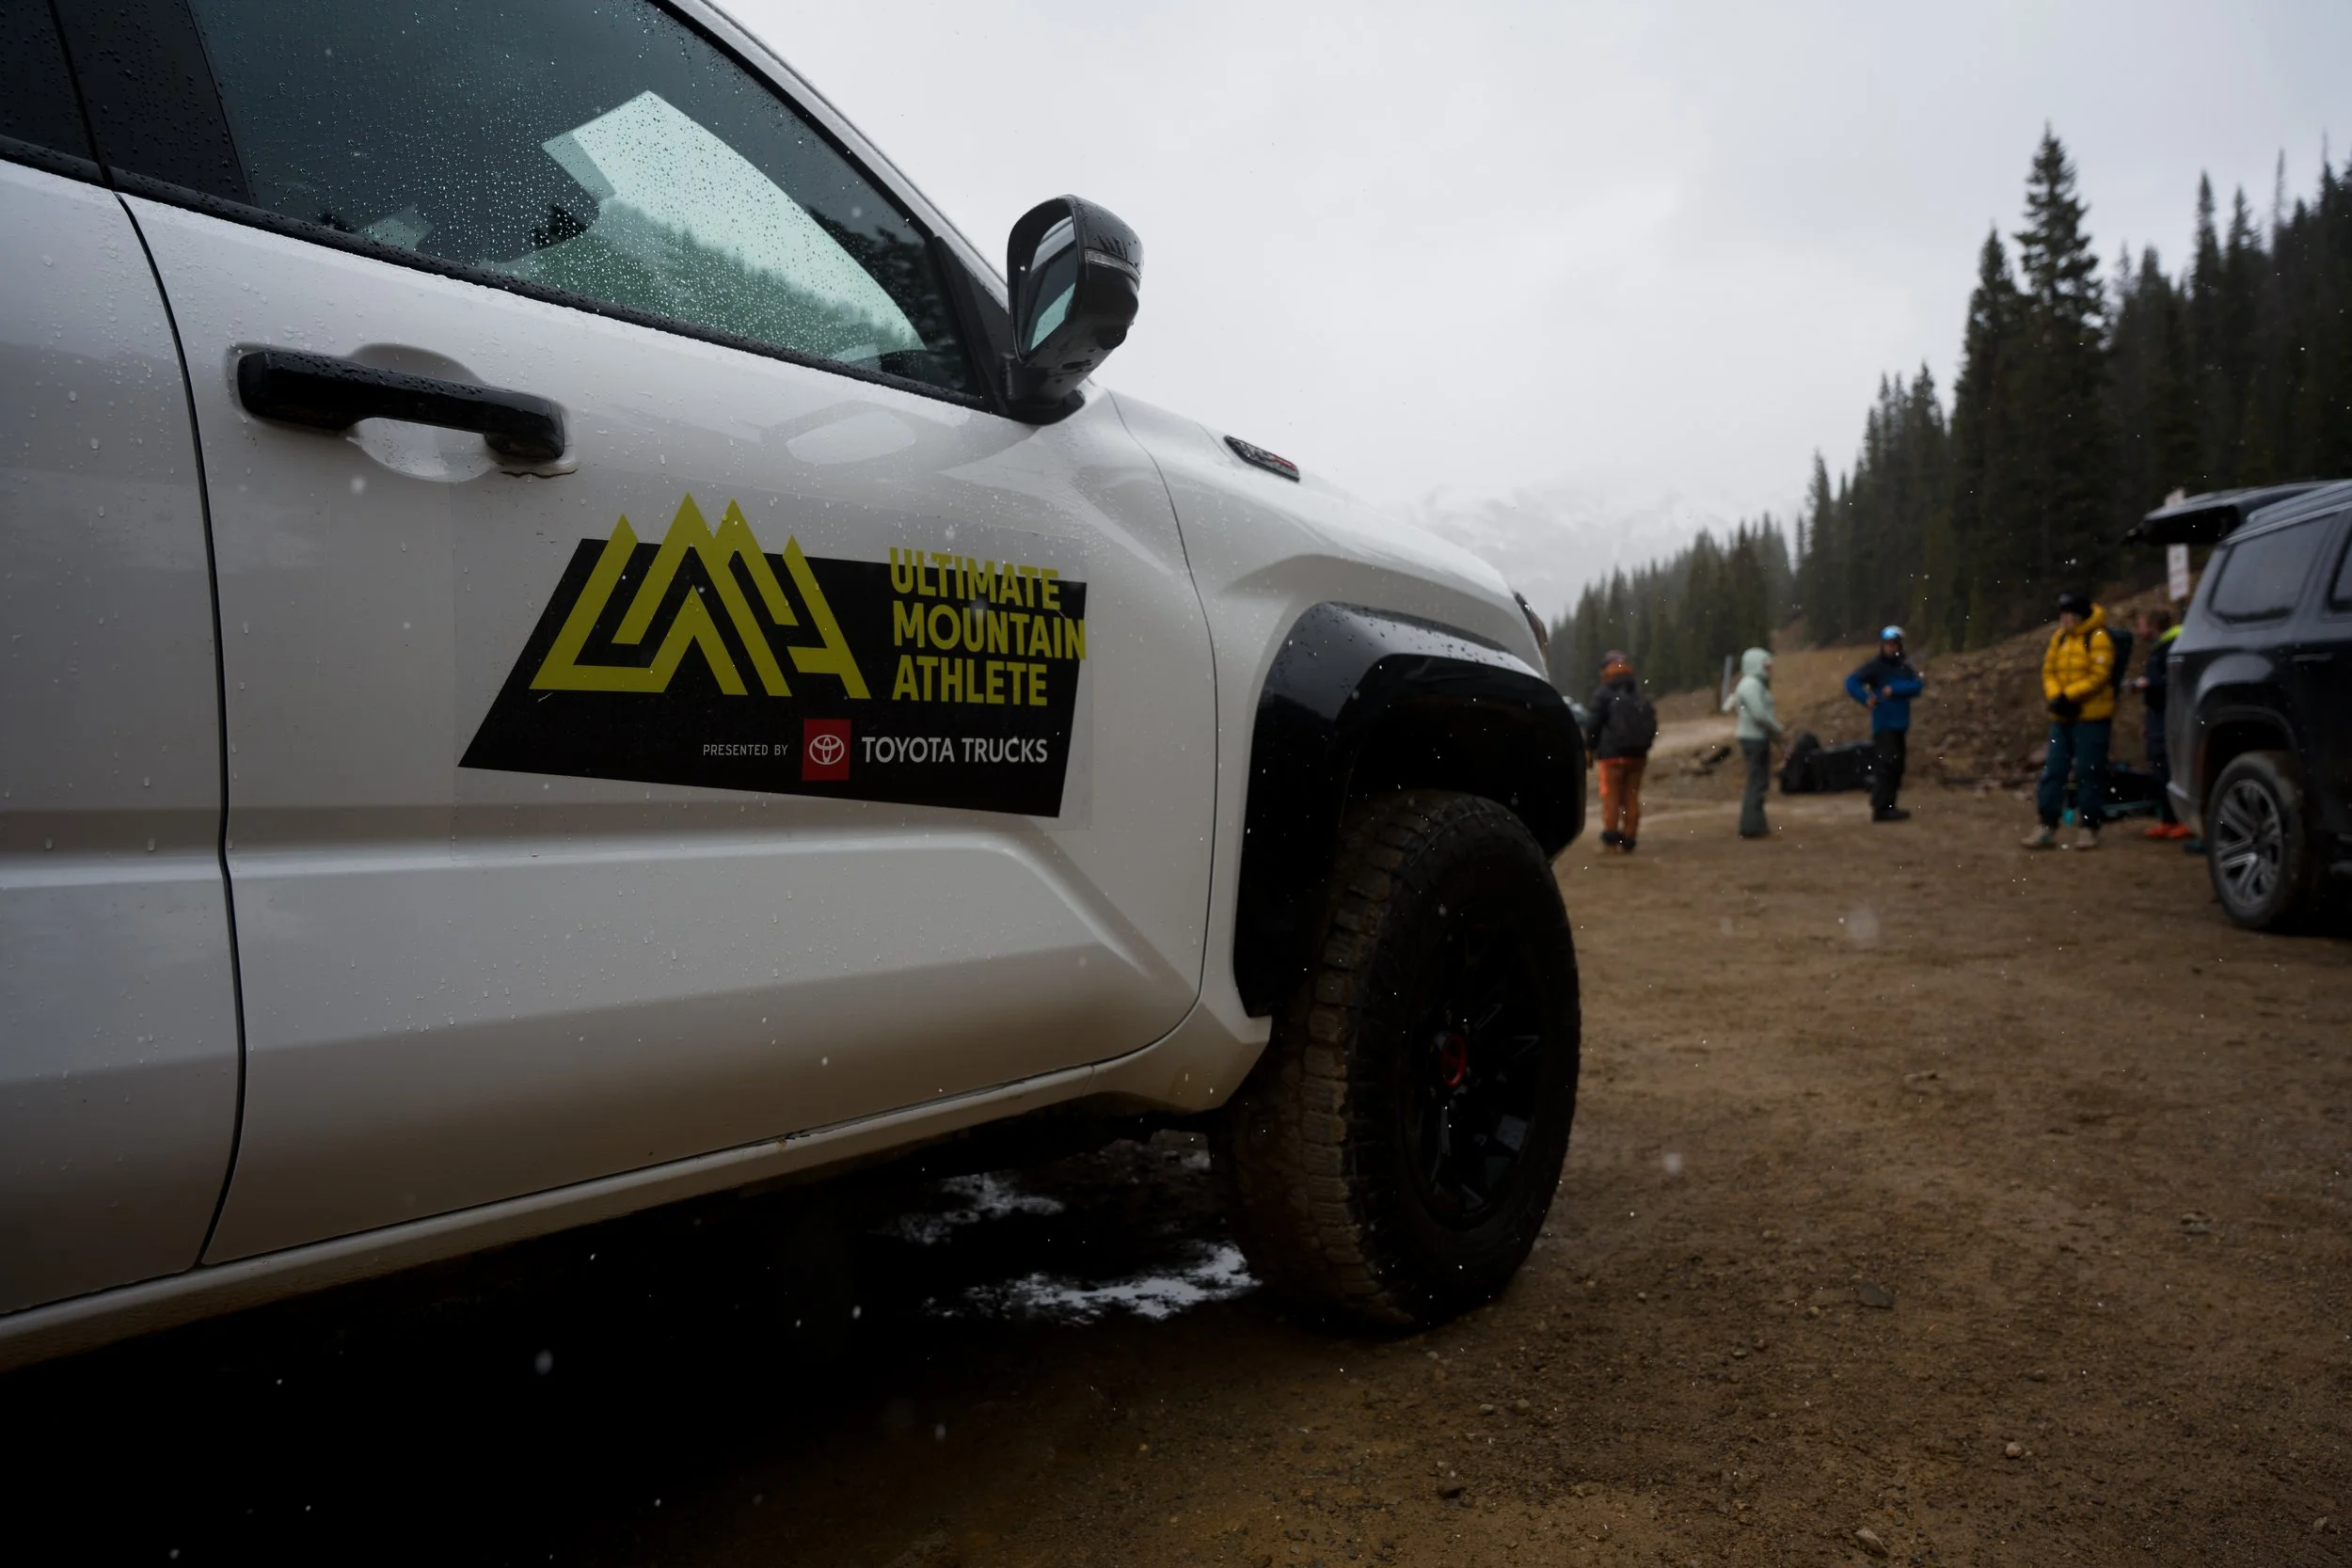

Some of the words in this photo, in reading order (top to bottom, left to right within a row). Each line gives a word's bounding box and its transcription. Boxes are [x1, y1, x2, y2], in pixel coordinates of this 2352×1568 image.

[889, 547, 1061, 610] ULTIMATE
[893, 600, 1087, 661] MOUNTAIN
[892, 654, 1048, 705] ATHLETE
[703, 744, 769, 756] PRESENTED
[774, 744, 788, 756] BY
[862, 736, 955, 763] TOYOTA
[961, 737, 1048, 763] TRUCKS
